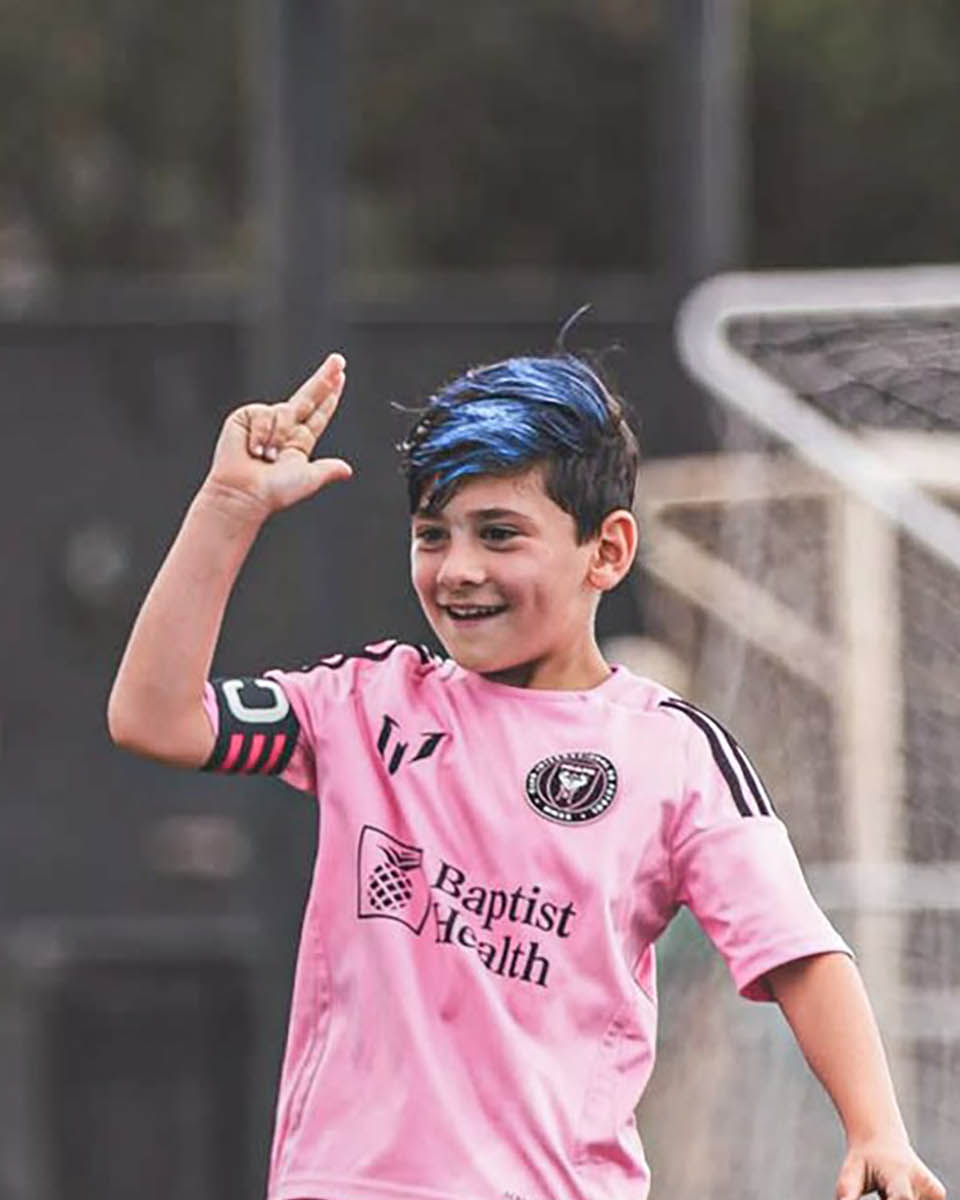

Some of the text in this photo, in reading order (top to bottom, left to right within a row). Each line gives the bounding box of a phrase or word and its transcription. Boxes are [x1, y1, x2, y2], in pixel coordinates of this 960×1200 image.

[222, 679, 289, 723] C
[430, 859, 577, 938] Baptist
[433, 902, 551, 988] Health
